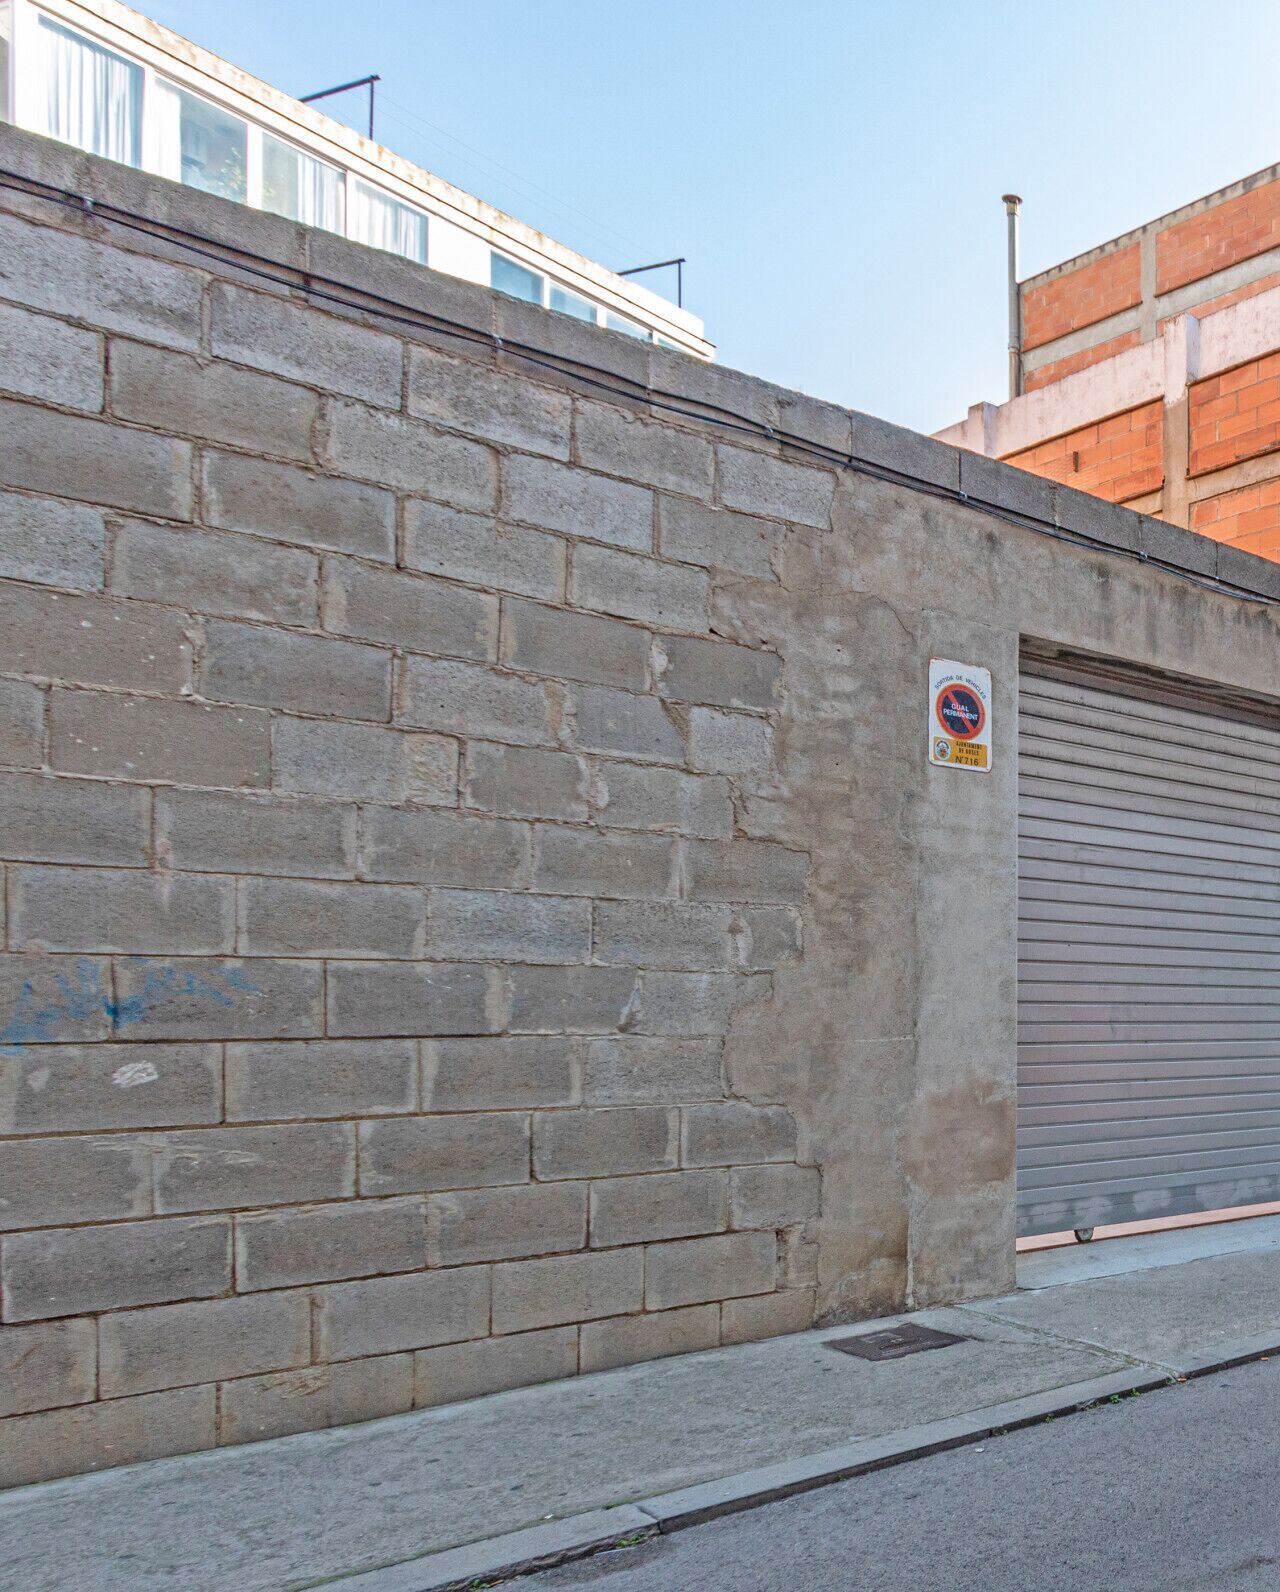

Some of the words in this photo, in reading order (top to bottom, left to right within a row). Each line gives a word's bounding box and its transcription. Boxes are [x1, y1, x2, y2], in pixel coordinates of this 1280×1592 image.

[934, 675, 953, 690] SORTIDA
[965, 677, 987, 700] VEHICLES
[943, 708, 978, 720] PERMANENT
